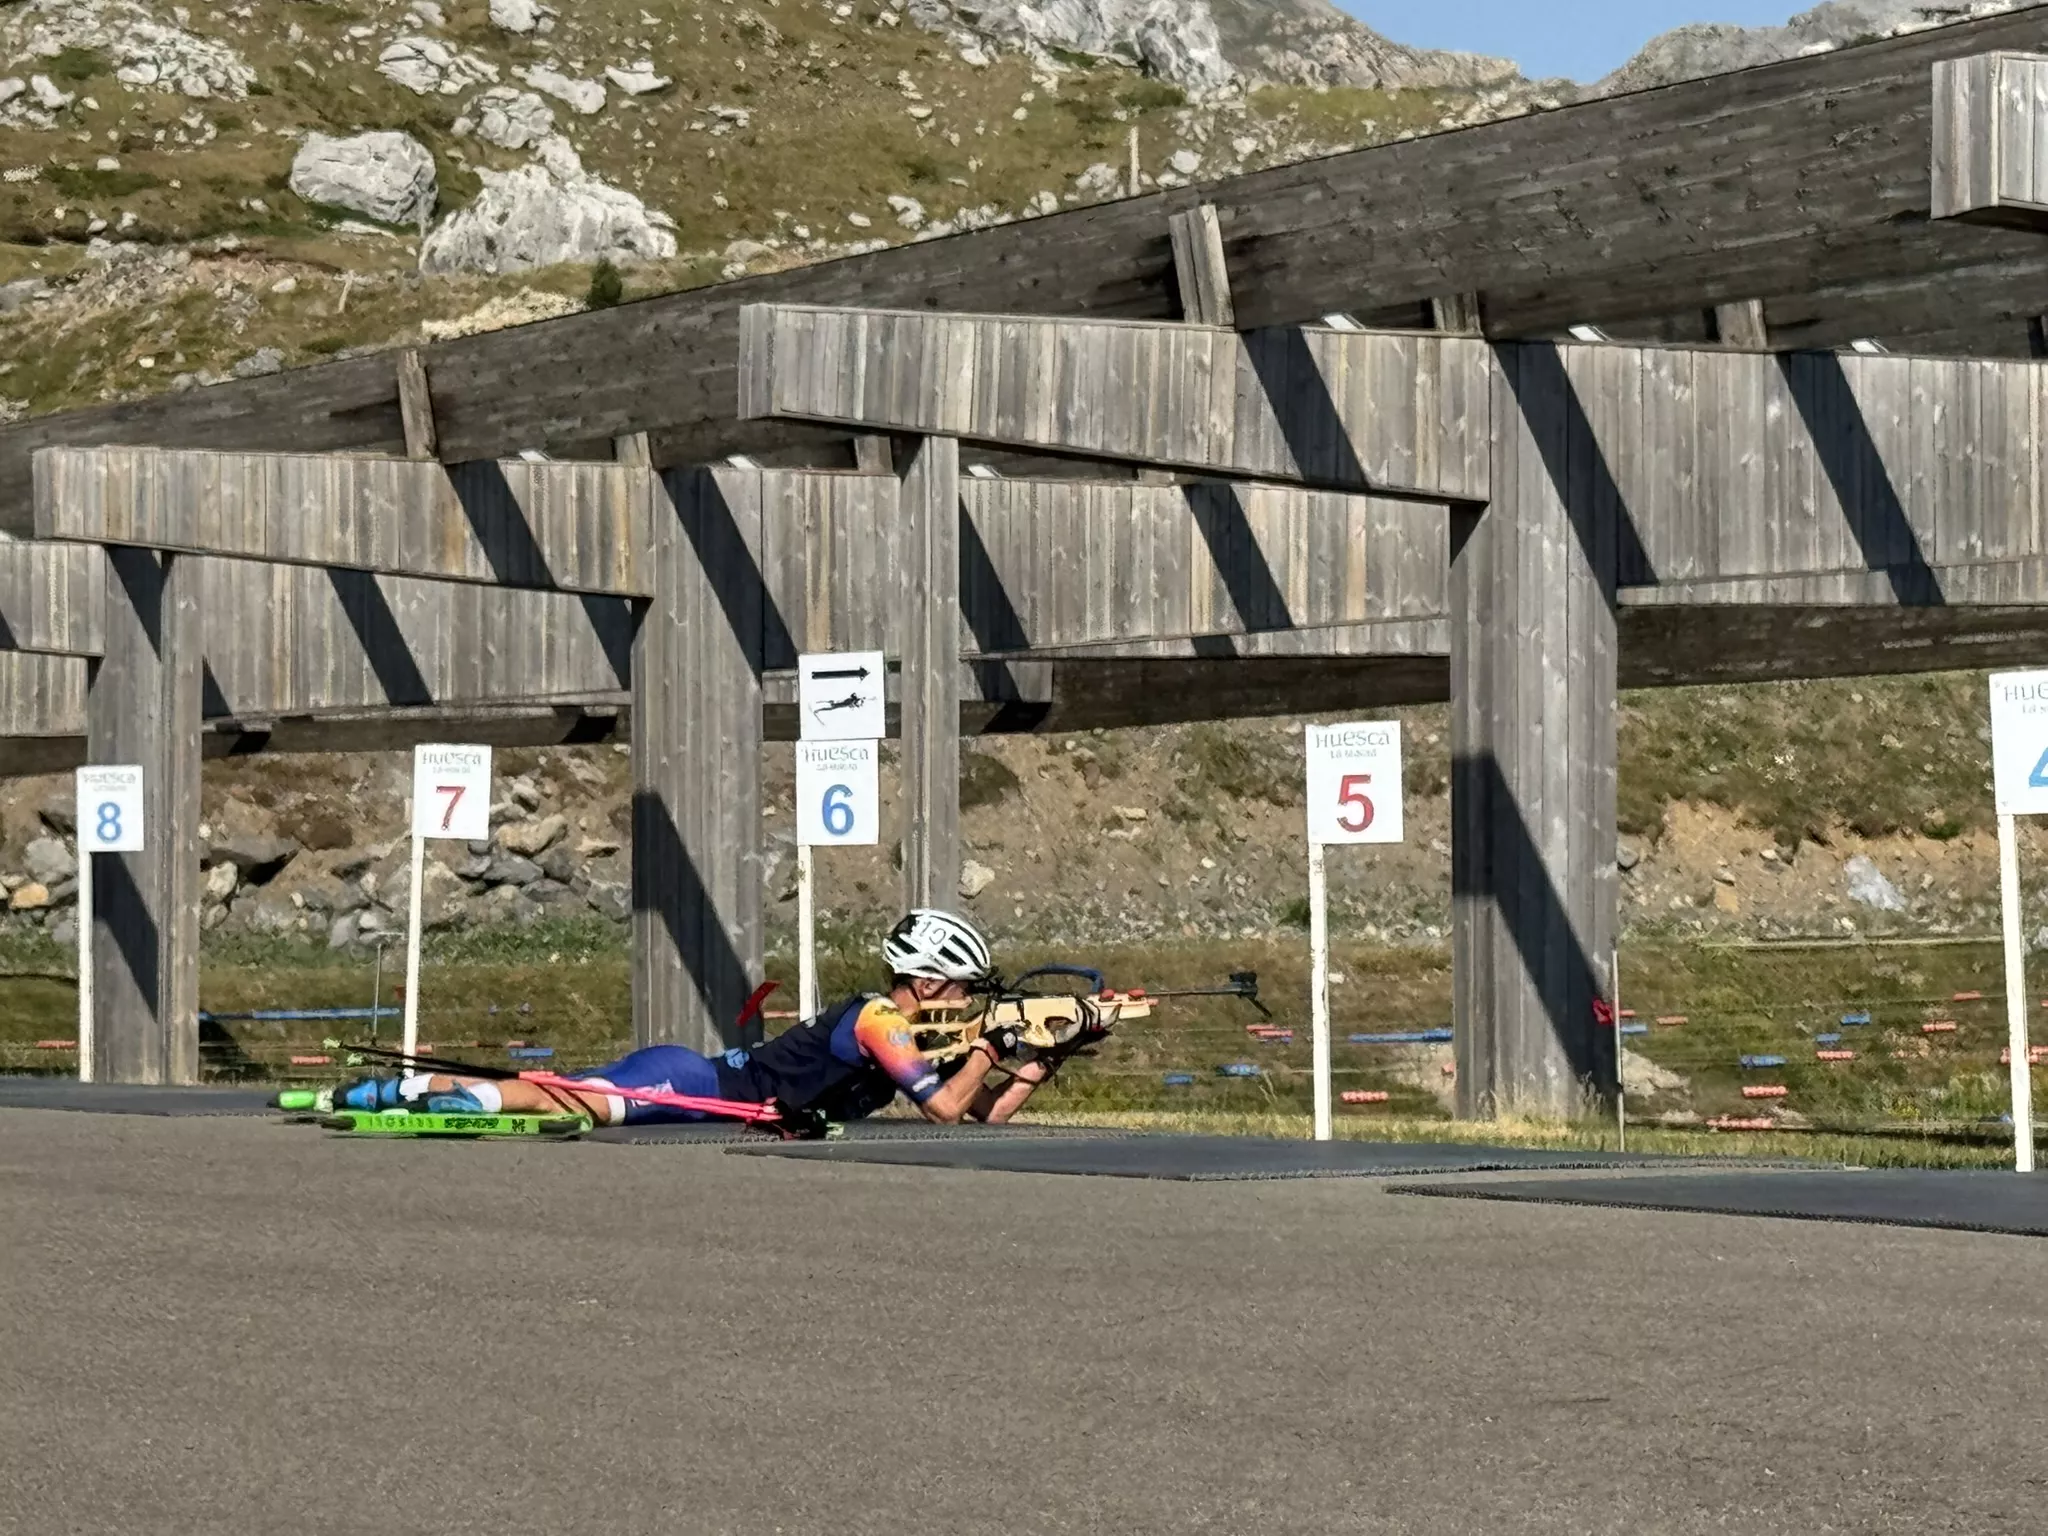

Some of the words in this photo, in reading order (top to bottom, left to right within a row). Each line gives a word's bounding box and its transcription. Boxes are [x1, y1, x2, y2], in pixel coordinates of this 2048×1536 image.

[804, 746, 869, 762] Huesca
[1315, 730, 1390, 749] Huesca
[96, 801, 123, 843] 8
[435, 785, 466, 831] 7
[821, 783, 855, 836] 6
[1336, 773, 1375, 833] 5
